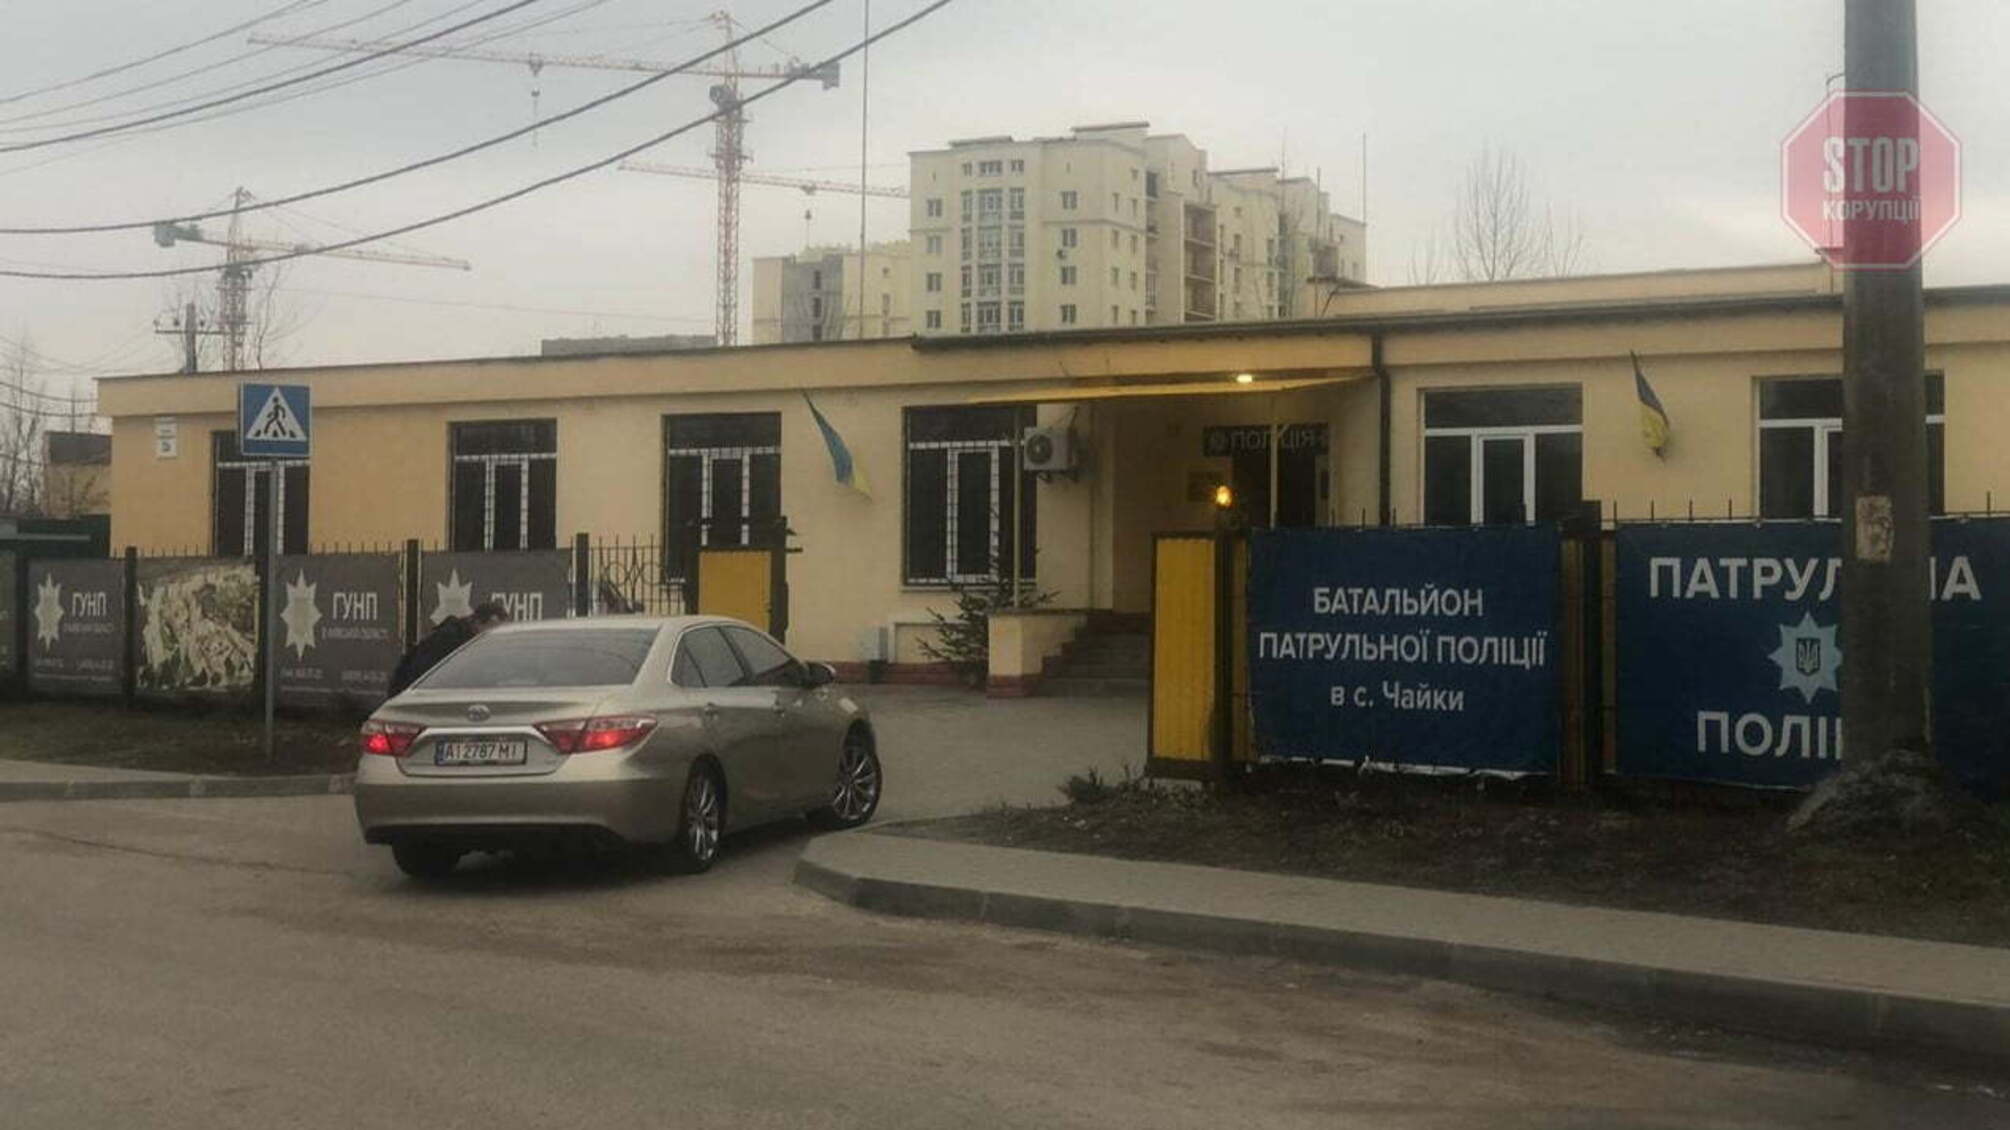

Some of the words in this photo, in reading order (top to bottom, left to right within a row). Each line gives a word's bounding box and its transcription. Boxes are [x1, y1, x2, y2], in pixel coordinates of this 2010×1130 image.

[72, 592, 106, 617] ГУНП
[332, 592, 377, 620] ГУНП
[1313, 584, 1483, 617] БАТАЛЬЙОН
[1259, 629, 1429, 662] ПАТРУЛЬНОЇ
[1436, 631, 1548, 669] ПОЛІЦІЇ
[1330, 685, 1344, 706] в
[1353, 687, 1374, 707] с.
[1383, 681, 1464, 711] Чайки
